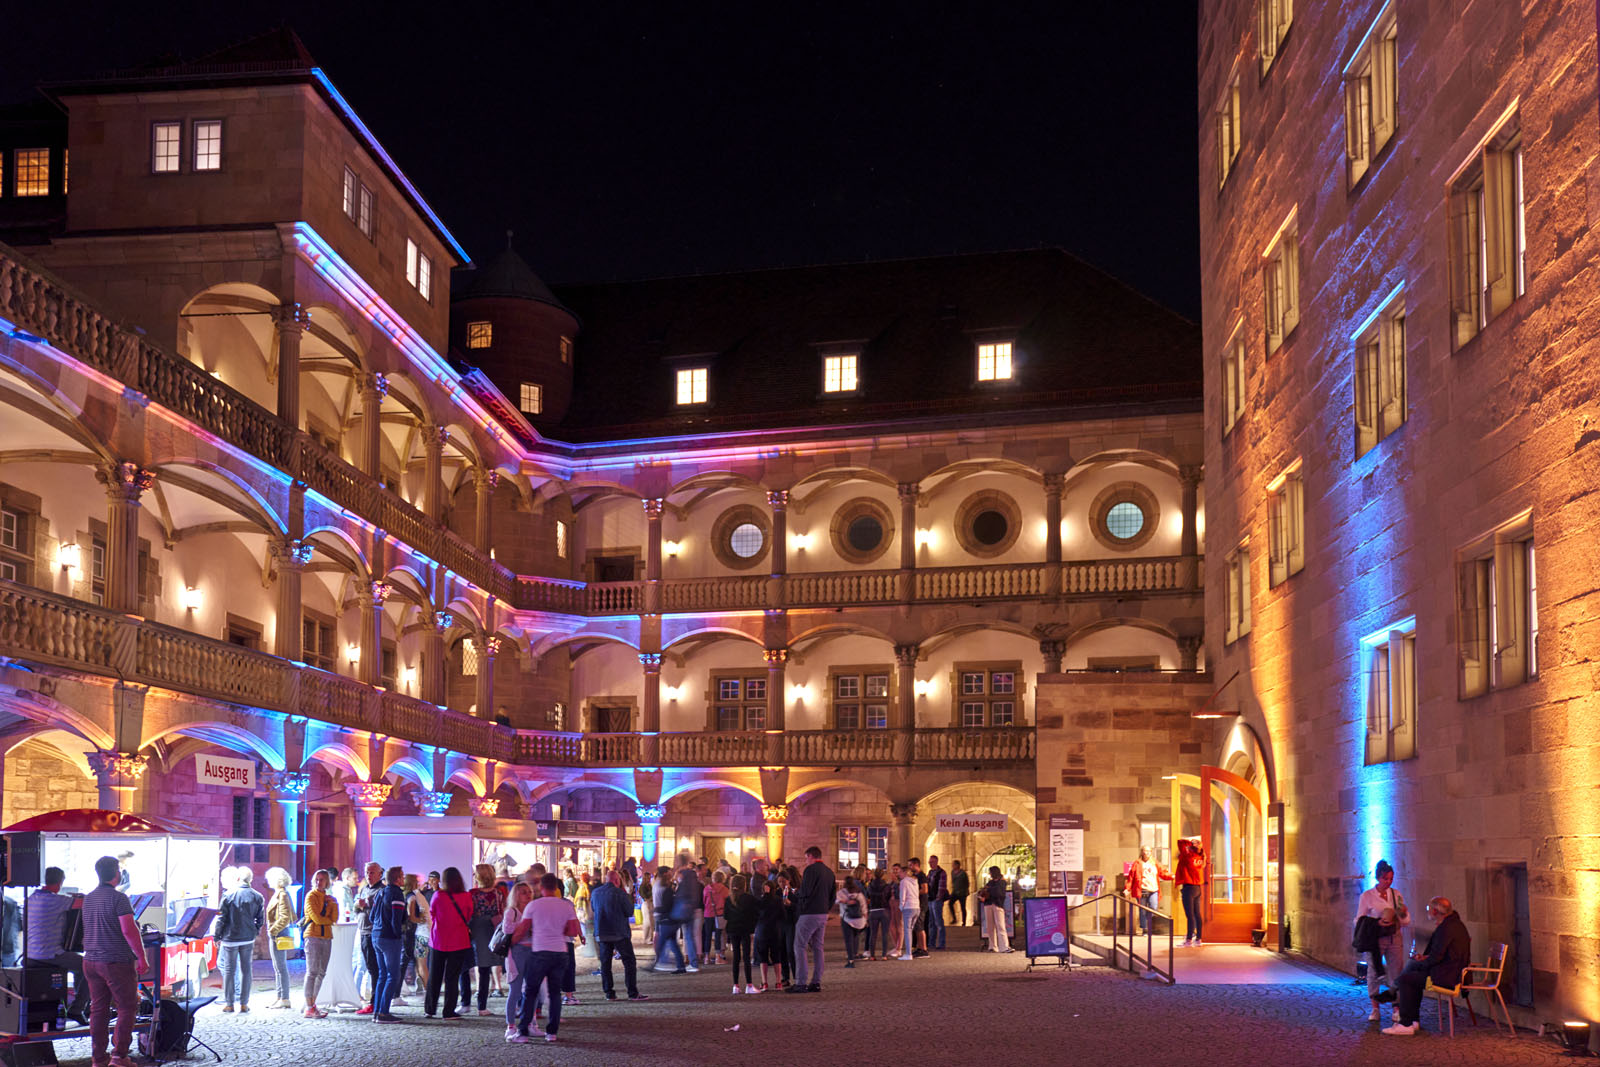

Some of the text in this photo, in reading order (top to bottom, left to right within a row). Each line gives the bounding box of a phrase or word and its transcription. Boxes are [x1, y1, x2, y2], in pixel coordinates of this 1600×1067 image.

[204, 760, 248, 784] Ausgang
[940, 819, 1004, 829] Kein Ausgang
